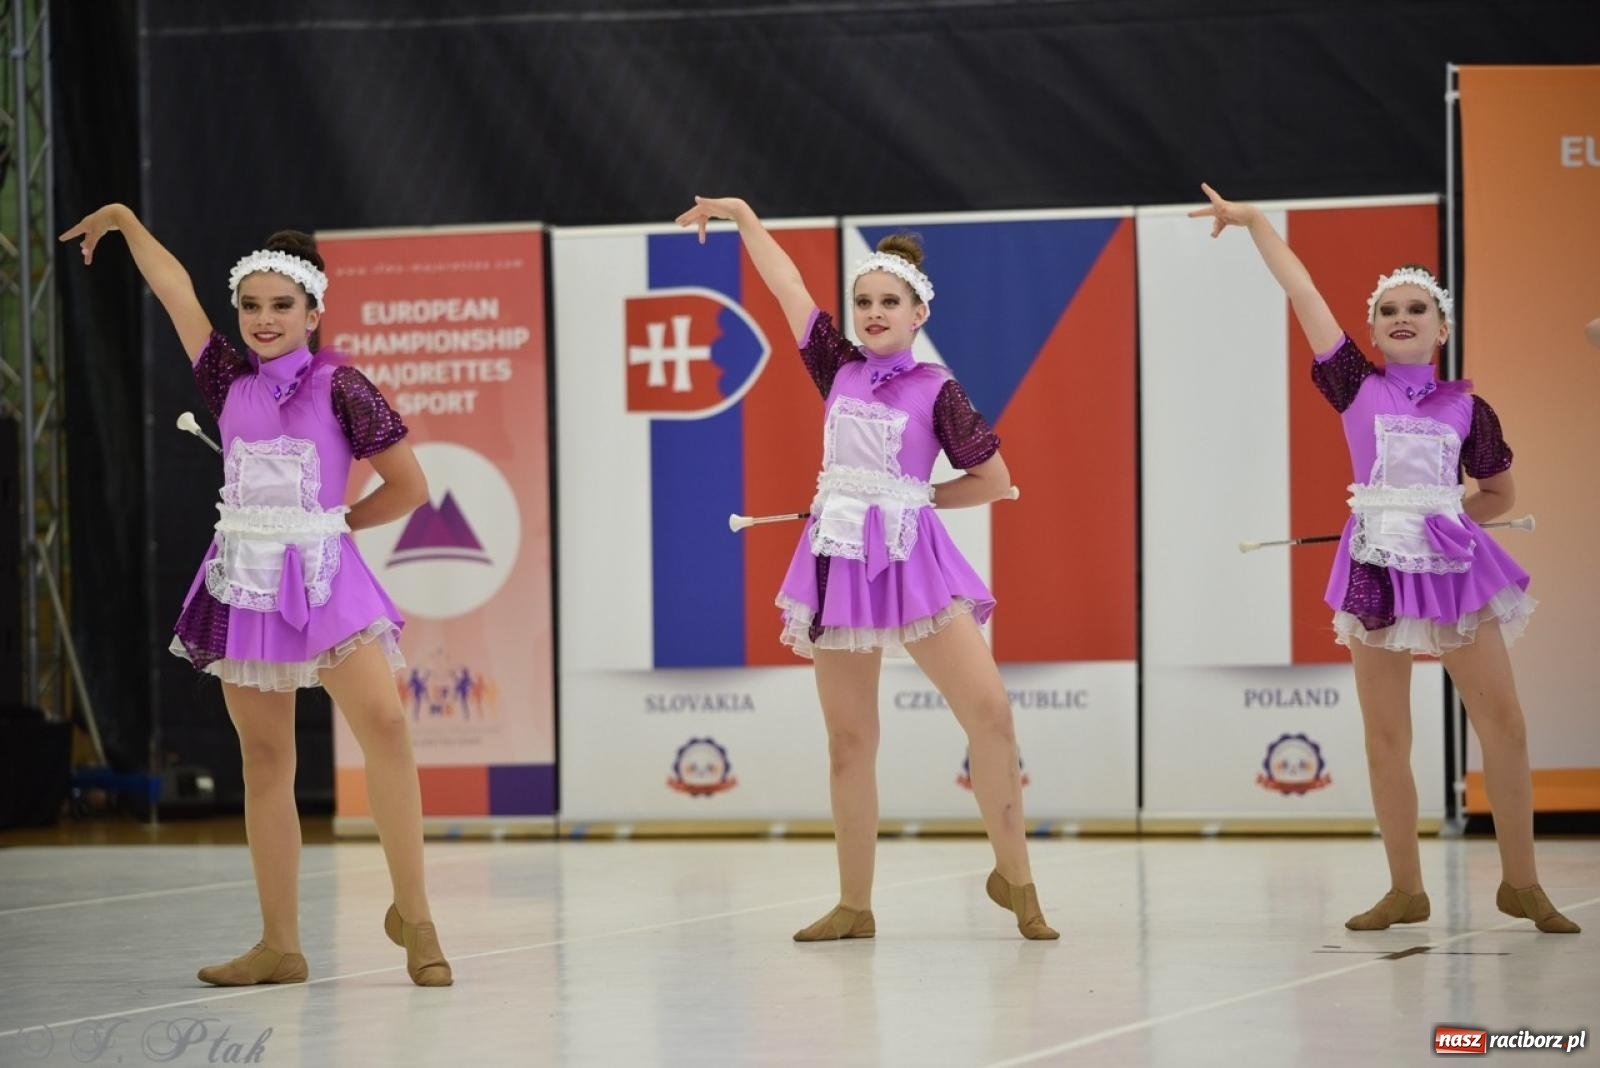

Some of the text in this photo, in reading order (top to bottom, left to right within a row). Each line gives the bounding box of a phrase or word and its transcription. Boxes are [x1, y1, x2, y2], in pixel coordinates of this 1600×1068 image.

[361, 298, 499, 325] EUROPEAN
[333, 327, 530, 355] CHAMPIONSHIP
[396, 391, 479, 416] SPORT
[645, 693, 755, 713] SLOVAKIA
[894, 691, 948, 710] CZEC
[1244, 688, 1340, 708] POLAND
